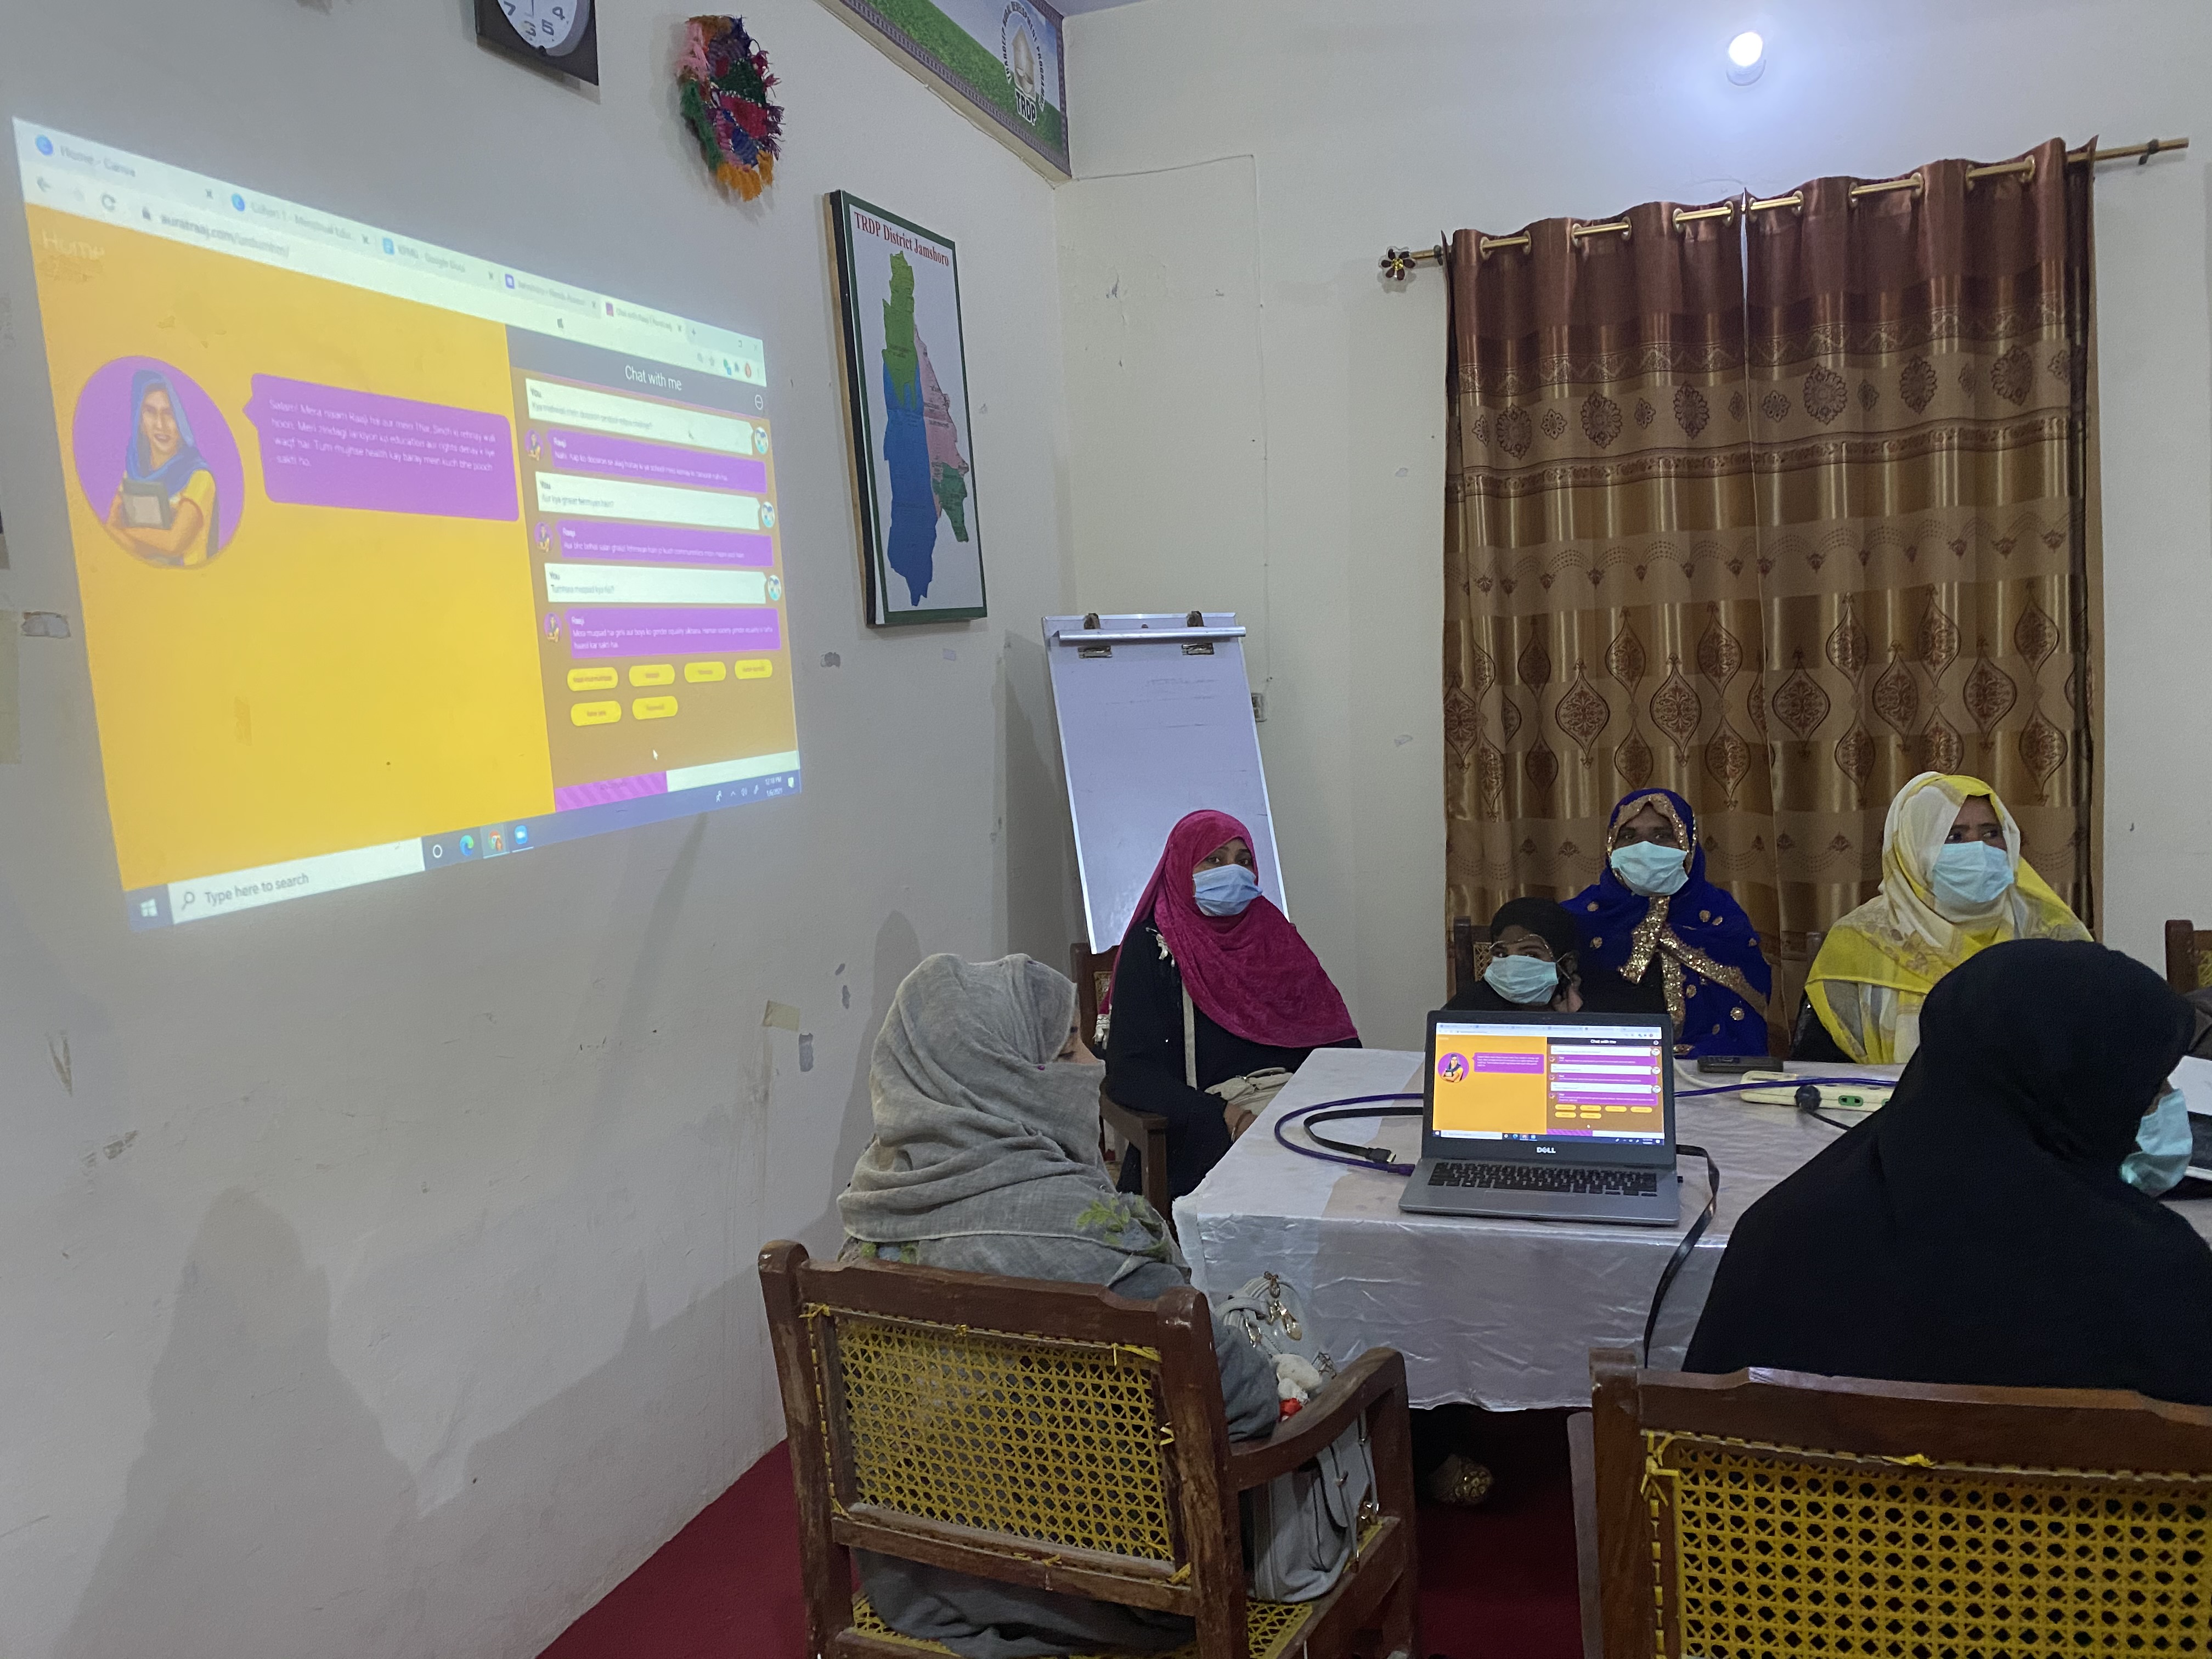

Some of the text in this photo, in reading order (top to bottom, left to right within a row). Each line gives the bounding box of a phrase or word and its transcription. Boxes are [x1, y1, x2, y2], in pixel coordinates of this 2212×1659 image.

[1015, 91, 1036, 124] TRDP
[854, 211, 949, 266] TRDP District Jamshoro
[624, 364, 682, 392] Chat with me
[530, 387, 541, 398] You
[313, 439, 333, 452] Tum
[388, 433, 425, 448] education
[437, 440, 458, 454] rights
[539, 480, 551, 489] You
[549, 571, 560, 580] You
[205, 873, 309, 906] Type here to search
